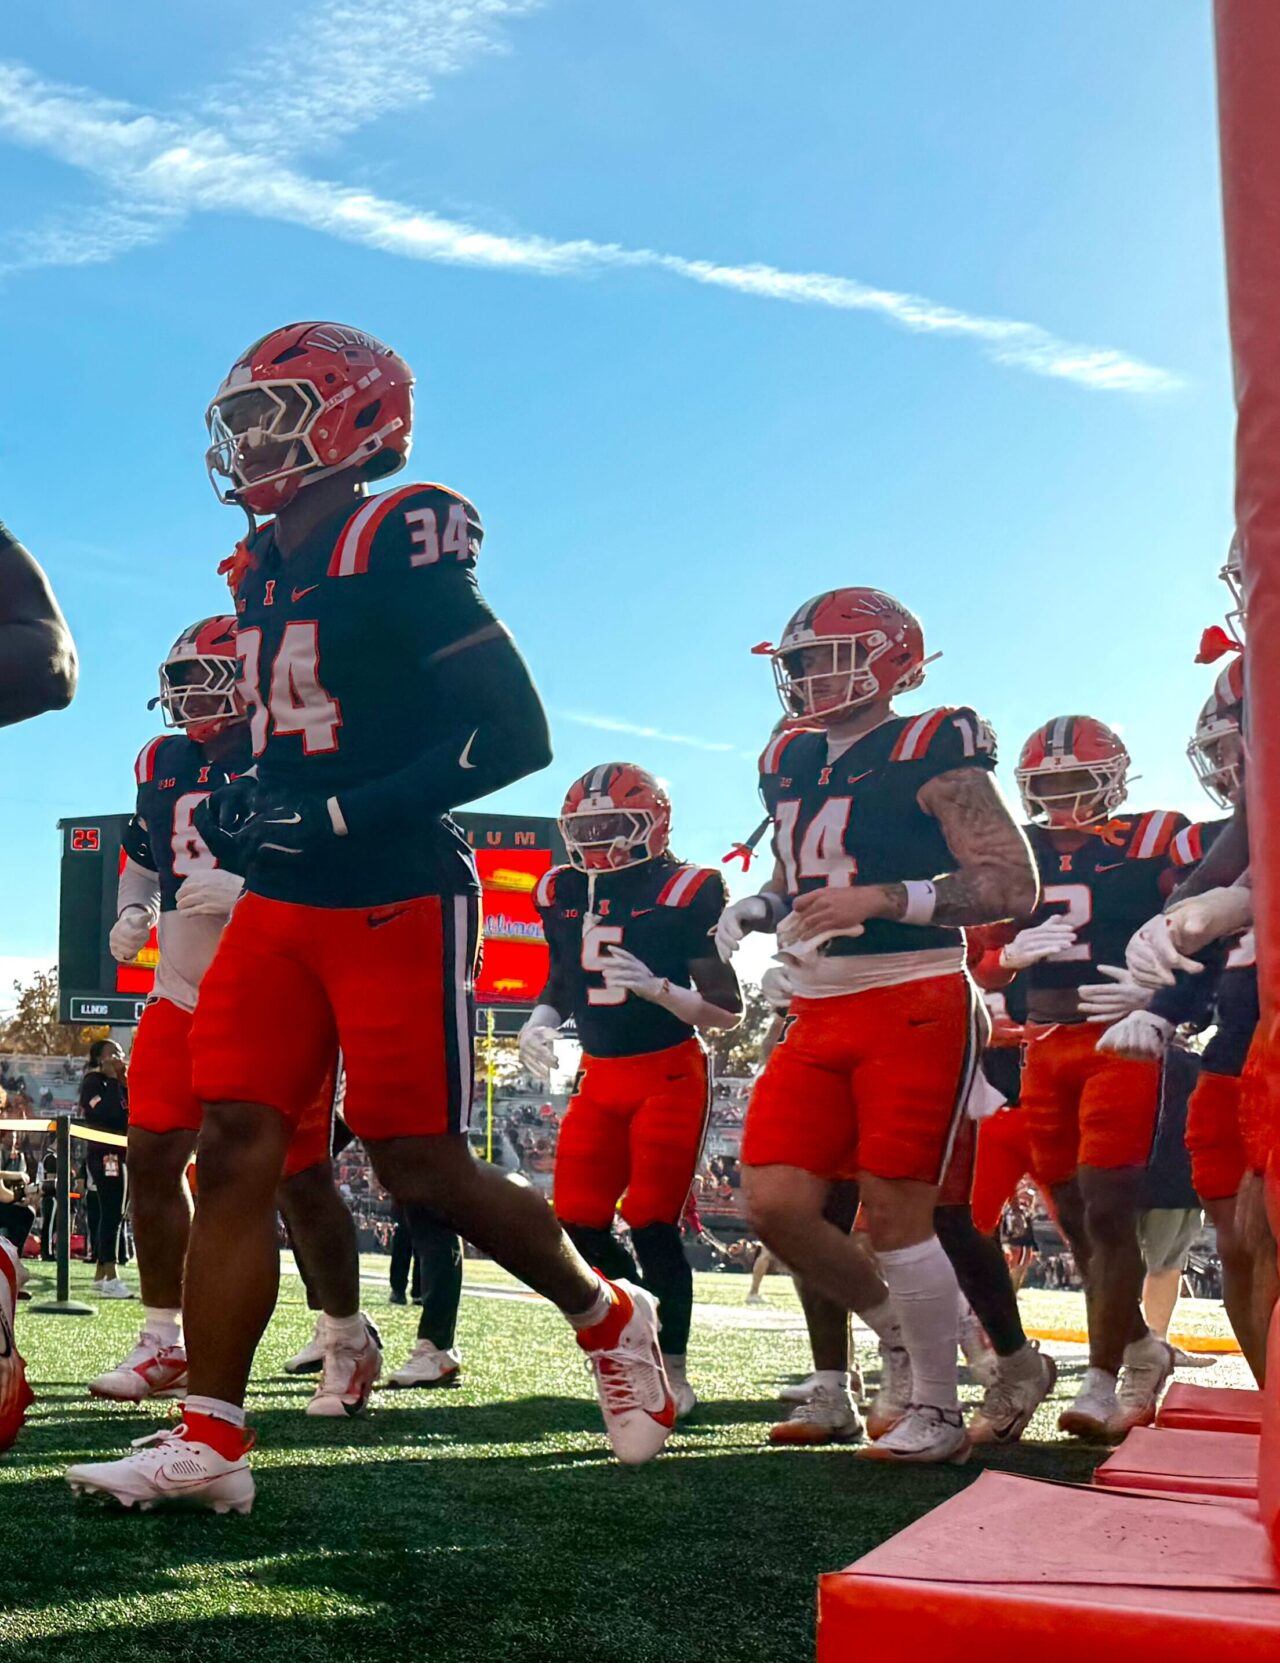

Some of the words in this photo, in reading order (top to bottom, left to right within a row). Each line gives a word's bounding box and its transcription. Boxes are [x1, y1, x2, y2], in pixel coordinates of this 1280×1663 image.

[404, 503, 471, 568] 34
[73, 830, 99, 849] 25
[773, 795, 859, 896] 14
[581, 925, 628, 1007] 5
